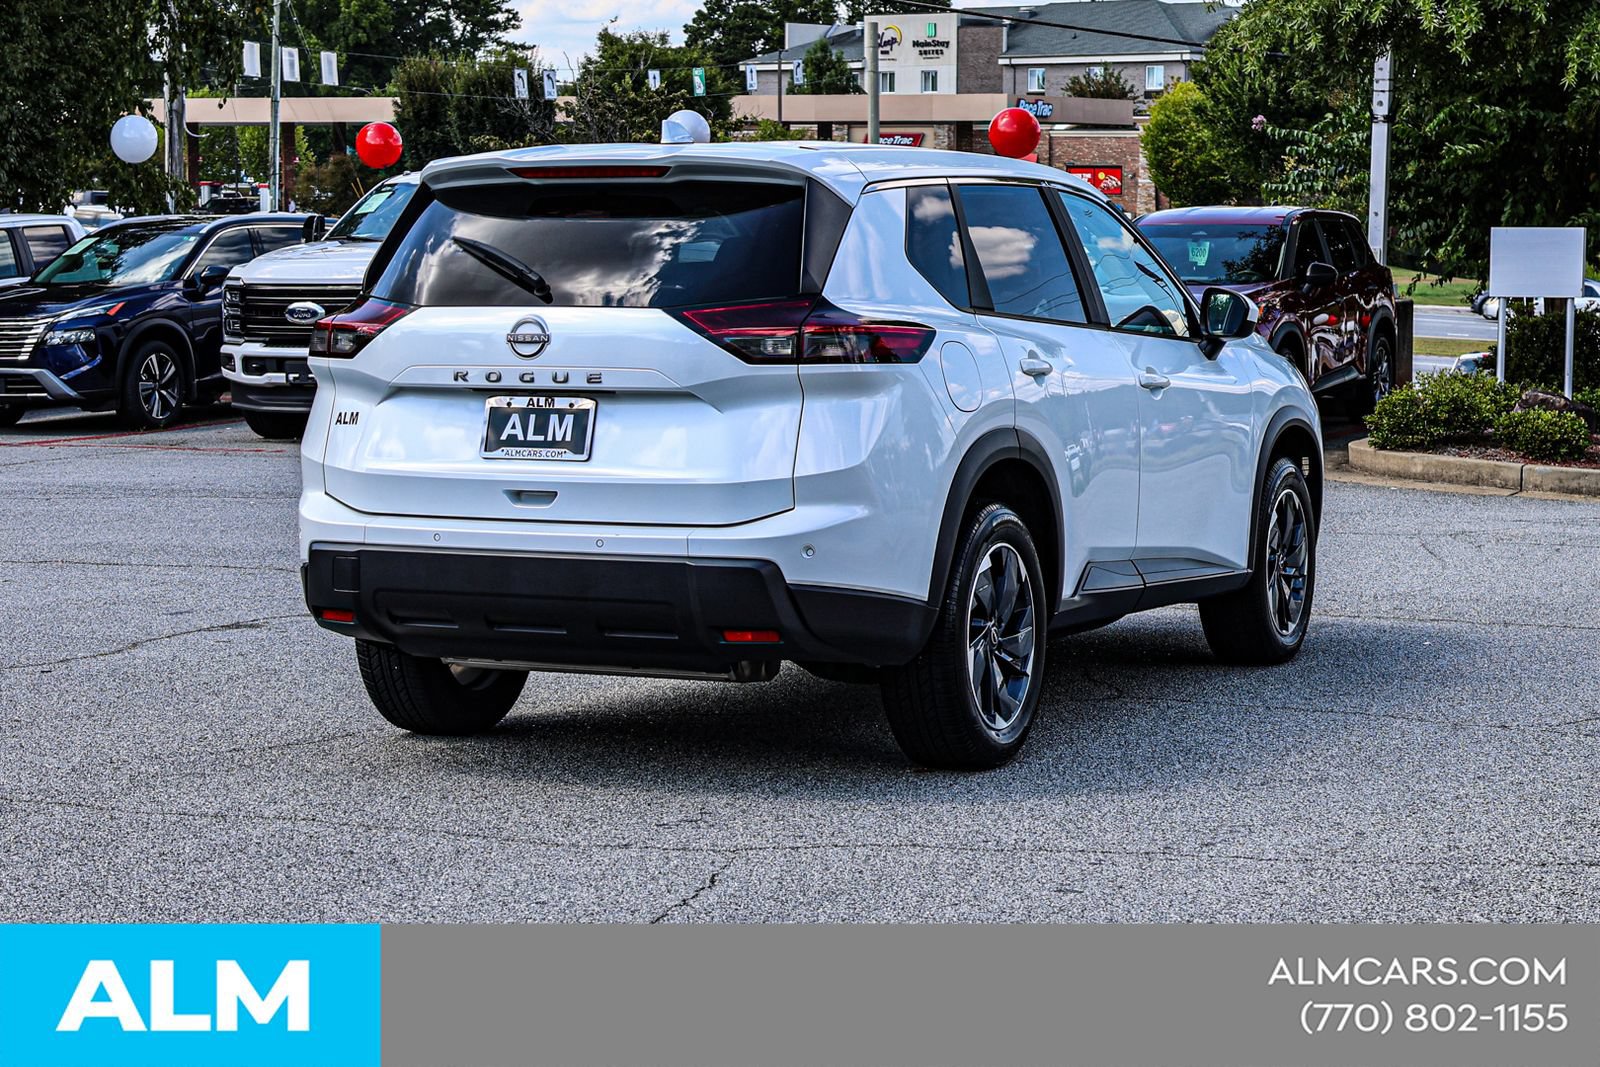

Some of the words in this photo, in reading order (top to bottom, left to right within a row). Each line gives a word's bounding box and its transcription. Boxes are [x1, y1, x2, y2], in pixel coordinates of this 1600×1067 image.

[912, 40, 950, 48] MainStay
[1191, 247, 1207, 258] 6200
[507, 334, 549, 342] NISSAN
[453, 370, 603, 384] ROGUE
[526, 397, 556, 408] ALM
[335, 411, 360, 425] ALM
[500, 413, 575, 442] ALM
[504, 449, 565, 458] ALMCARS.COM
